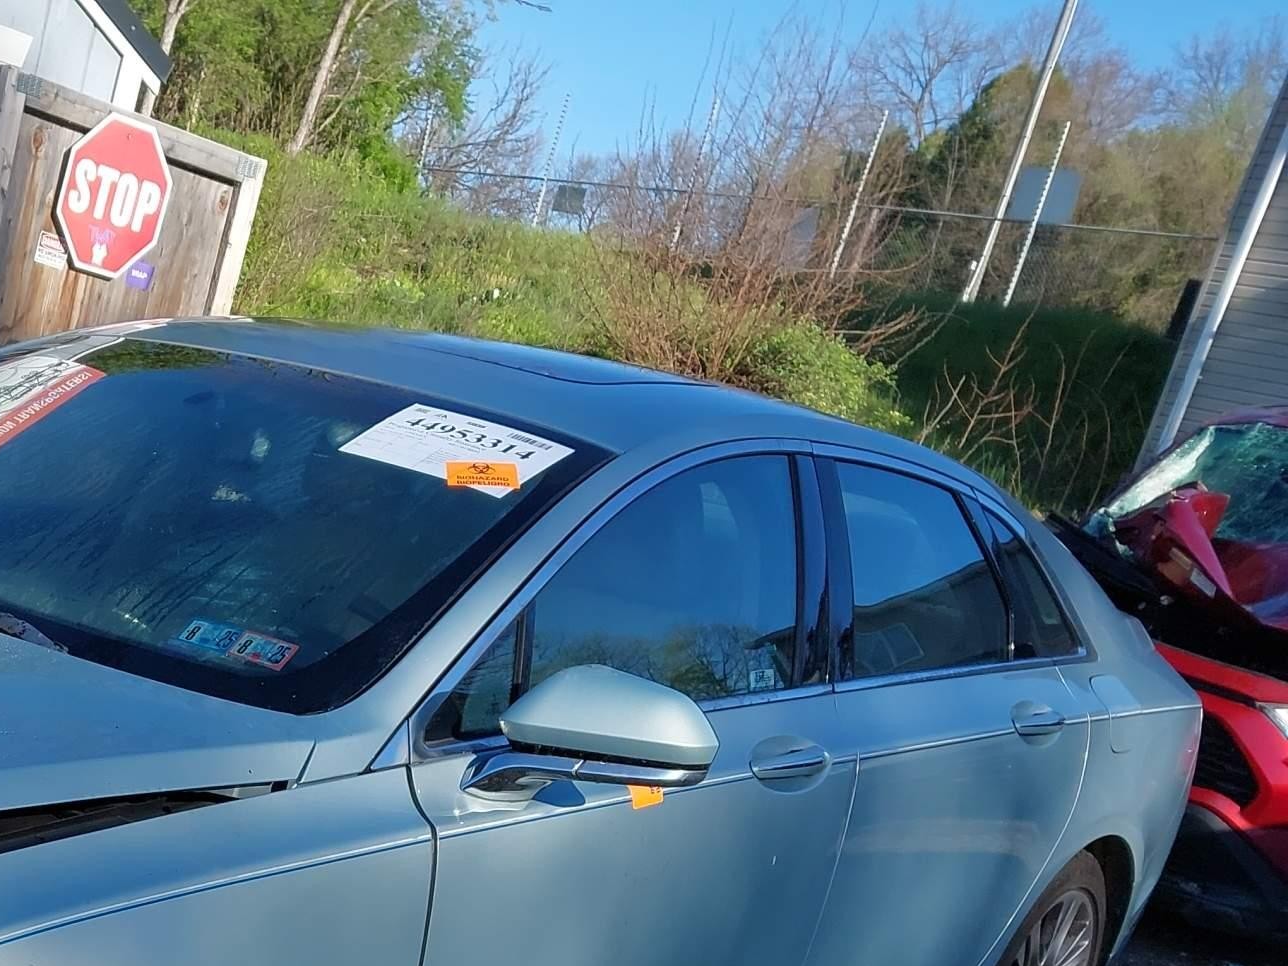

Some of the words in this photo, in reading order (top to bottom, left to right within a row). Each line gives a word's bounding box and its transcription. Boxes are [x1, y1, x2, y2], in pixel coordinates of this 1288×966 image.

[68, 158, 161, 233] STOP
[405, 417, 537, 460] 44953314
[456, 474, 509, 482] BIOHAZARD
